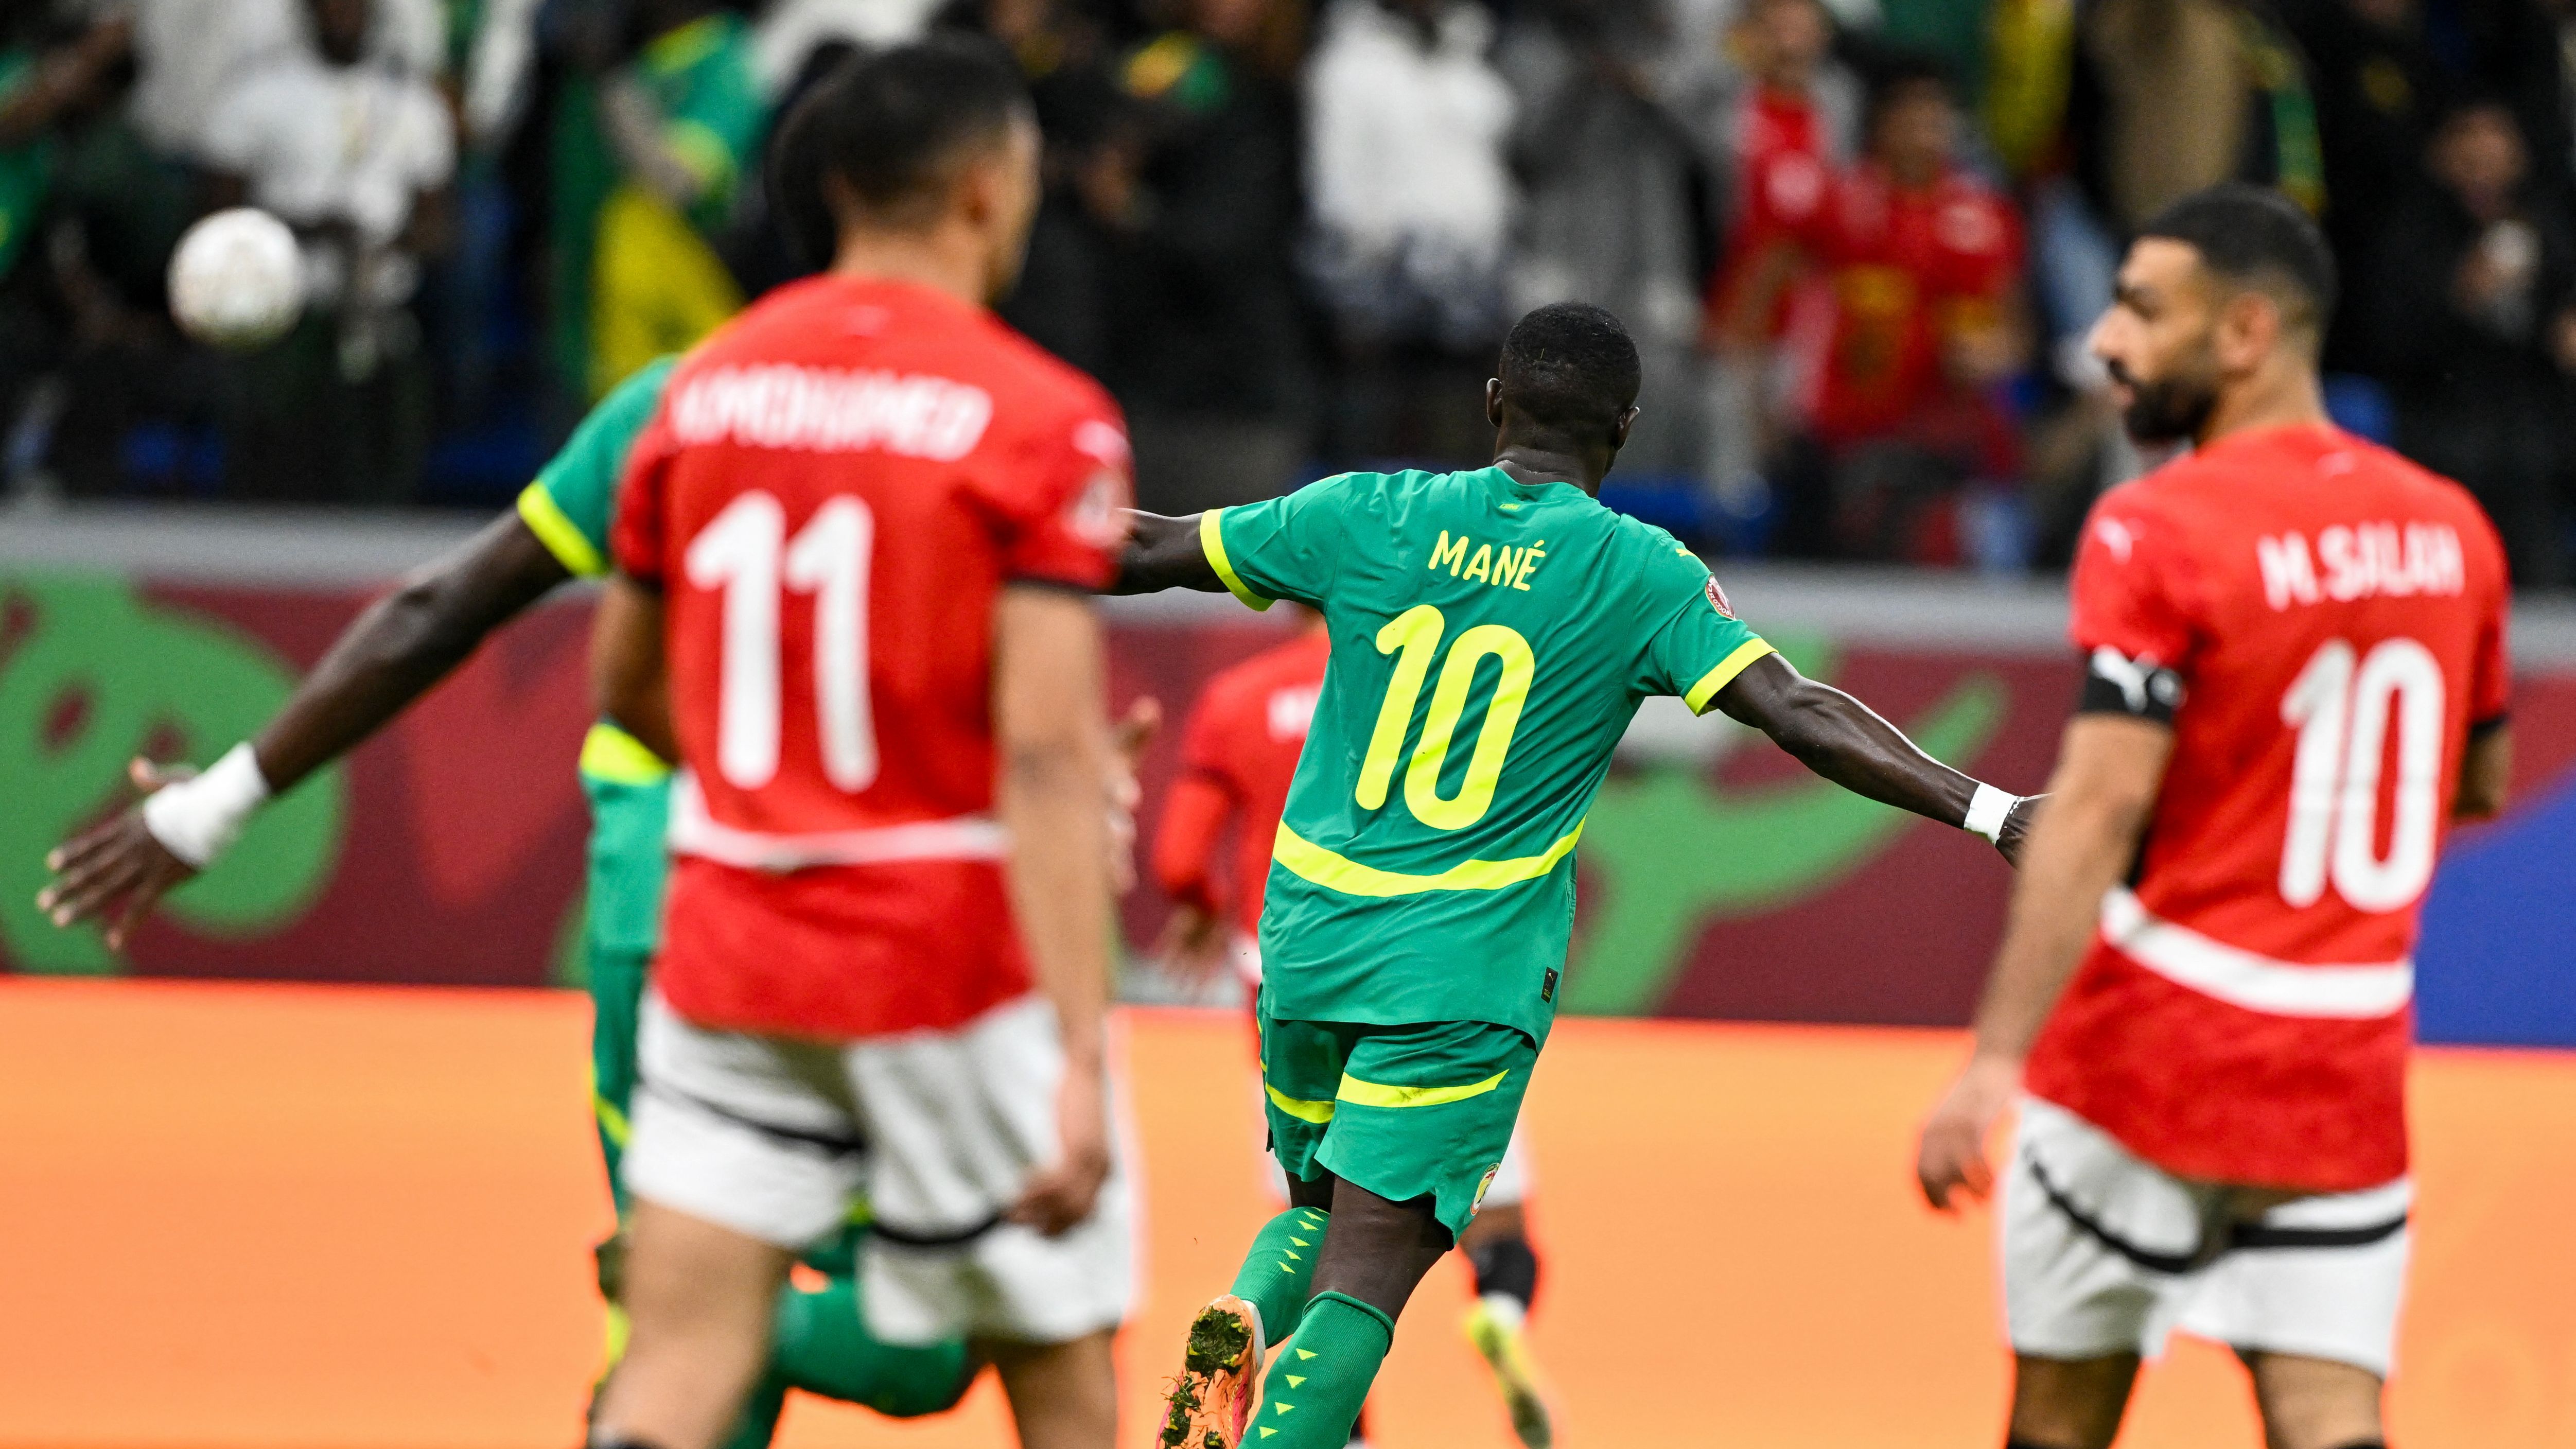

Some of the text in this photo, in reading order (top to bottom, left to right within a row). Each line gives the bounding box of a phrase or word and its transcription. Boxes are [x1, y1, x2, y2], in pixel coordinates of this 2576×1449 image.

[686, 493, 875, 789] 11
[1428, 530, 1546, 591] MANÉ
[1355, 604, 1536, 830] 10
[2280, 638, 2445, 912] 10
